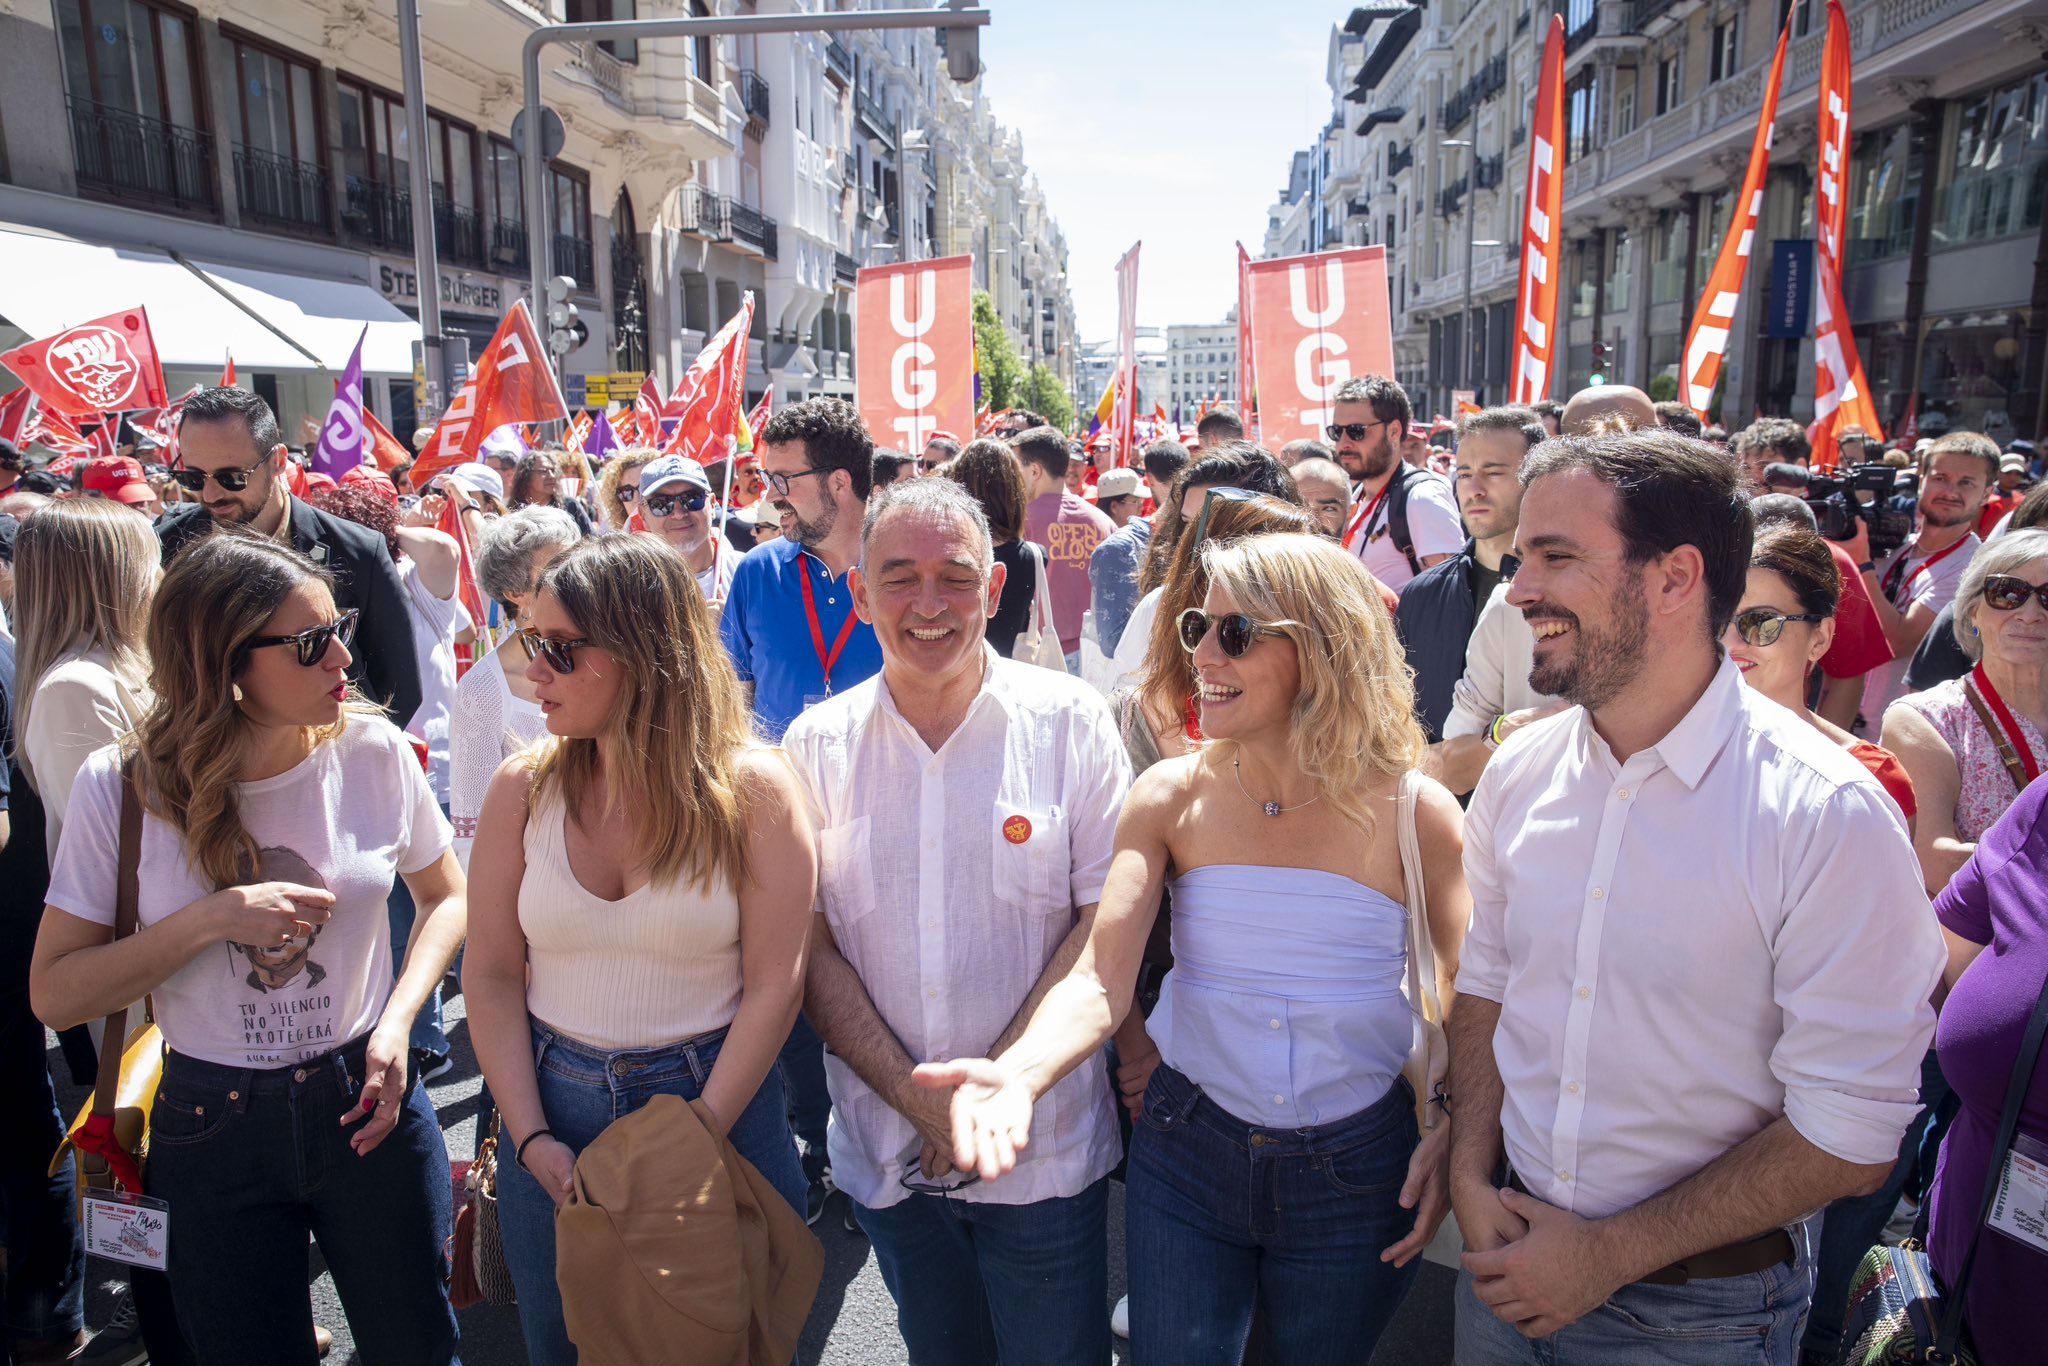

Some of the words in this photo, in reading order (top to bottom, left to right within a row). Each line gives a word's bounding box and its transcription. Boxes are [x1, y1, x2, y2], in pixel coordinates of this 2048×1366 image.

[379, 265, 418, 297] STE
[440, 275, 500, 309] BURGER
[1784, 260, 1798, 327] IBEROSTAR
[890, 269, 938, 455] UGT
[112, 469, 128, 477] UGT
[238, 1003, 257, 1017] TU
[269, 995, 332, 1015] SILENCIO
[243, 1017, 268, 1031] NO
[281, 1015, 294, 1028] TE
[245, 1018, 333, 1045] PROTEGERÁ
[1993, 1150, 2012, 1221] INSTITUCIONAL
